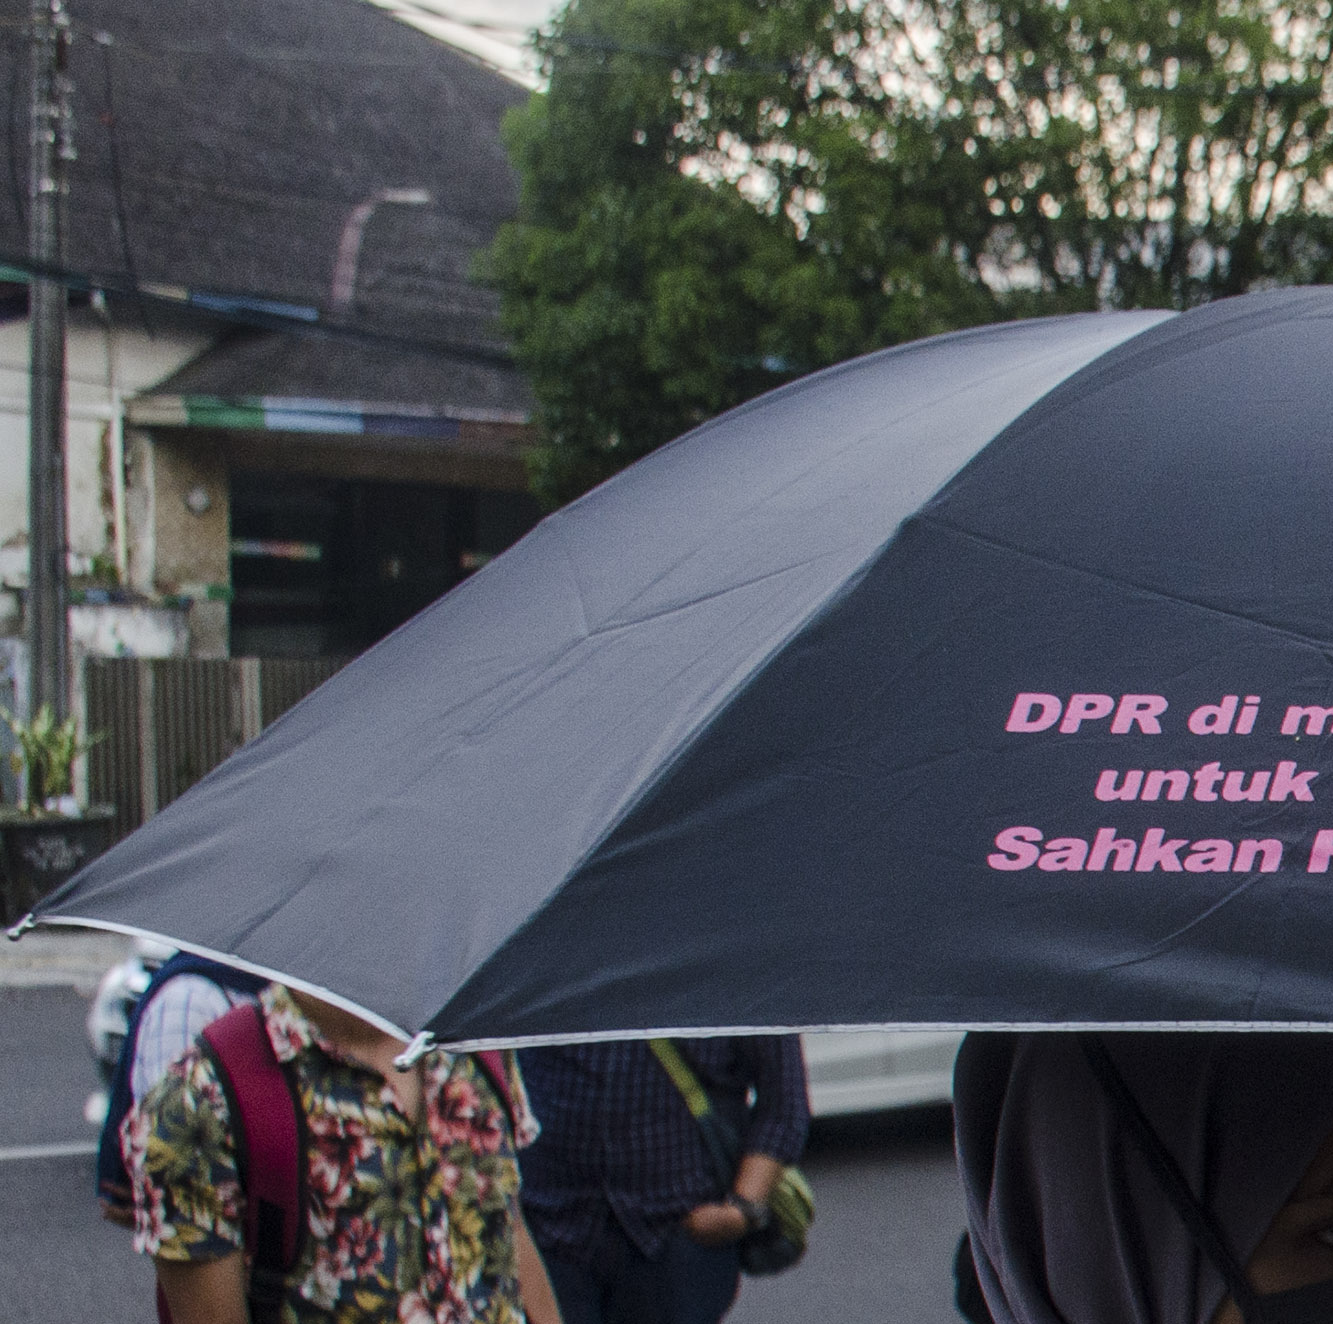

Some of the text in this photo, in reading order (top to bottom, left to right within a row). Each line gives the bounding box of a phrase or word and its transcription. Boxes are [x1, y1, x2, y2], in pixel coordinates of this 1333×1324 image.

[1004, 692, 1166, 735] DPR
[1186, 694, 1260, 735] di
[1093, 759, 1316, 802] untuk
[986, 825, 1283, 873] Sahkan
